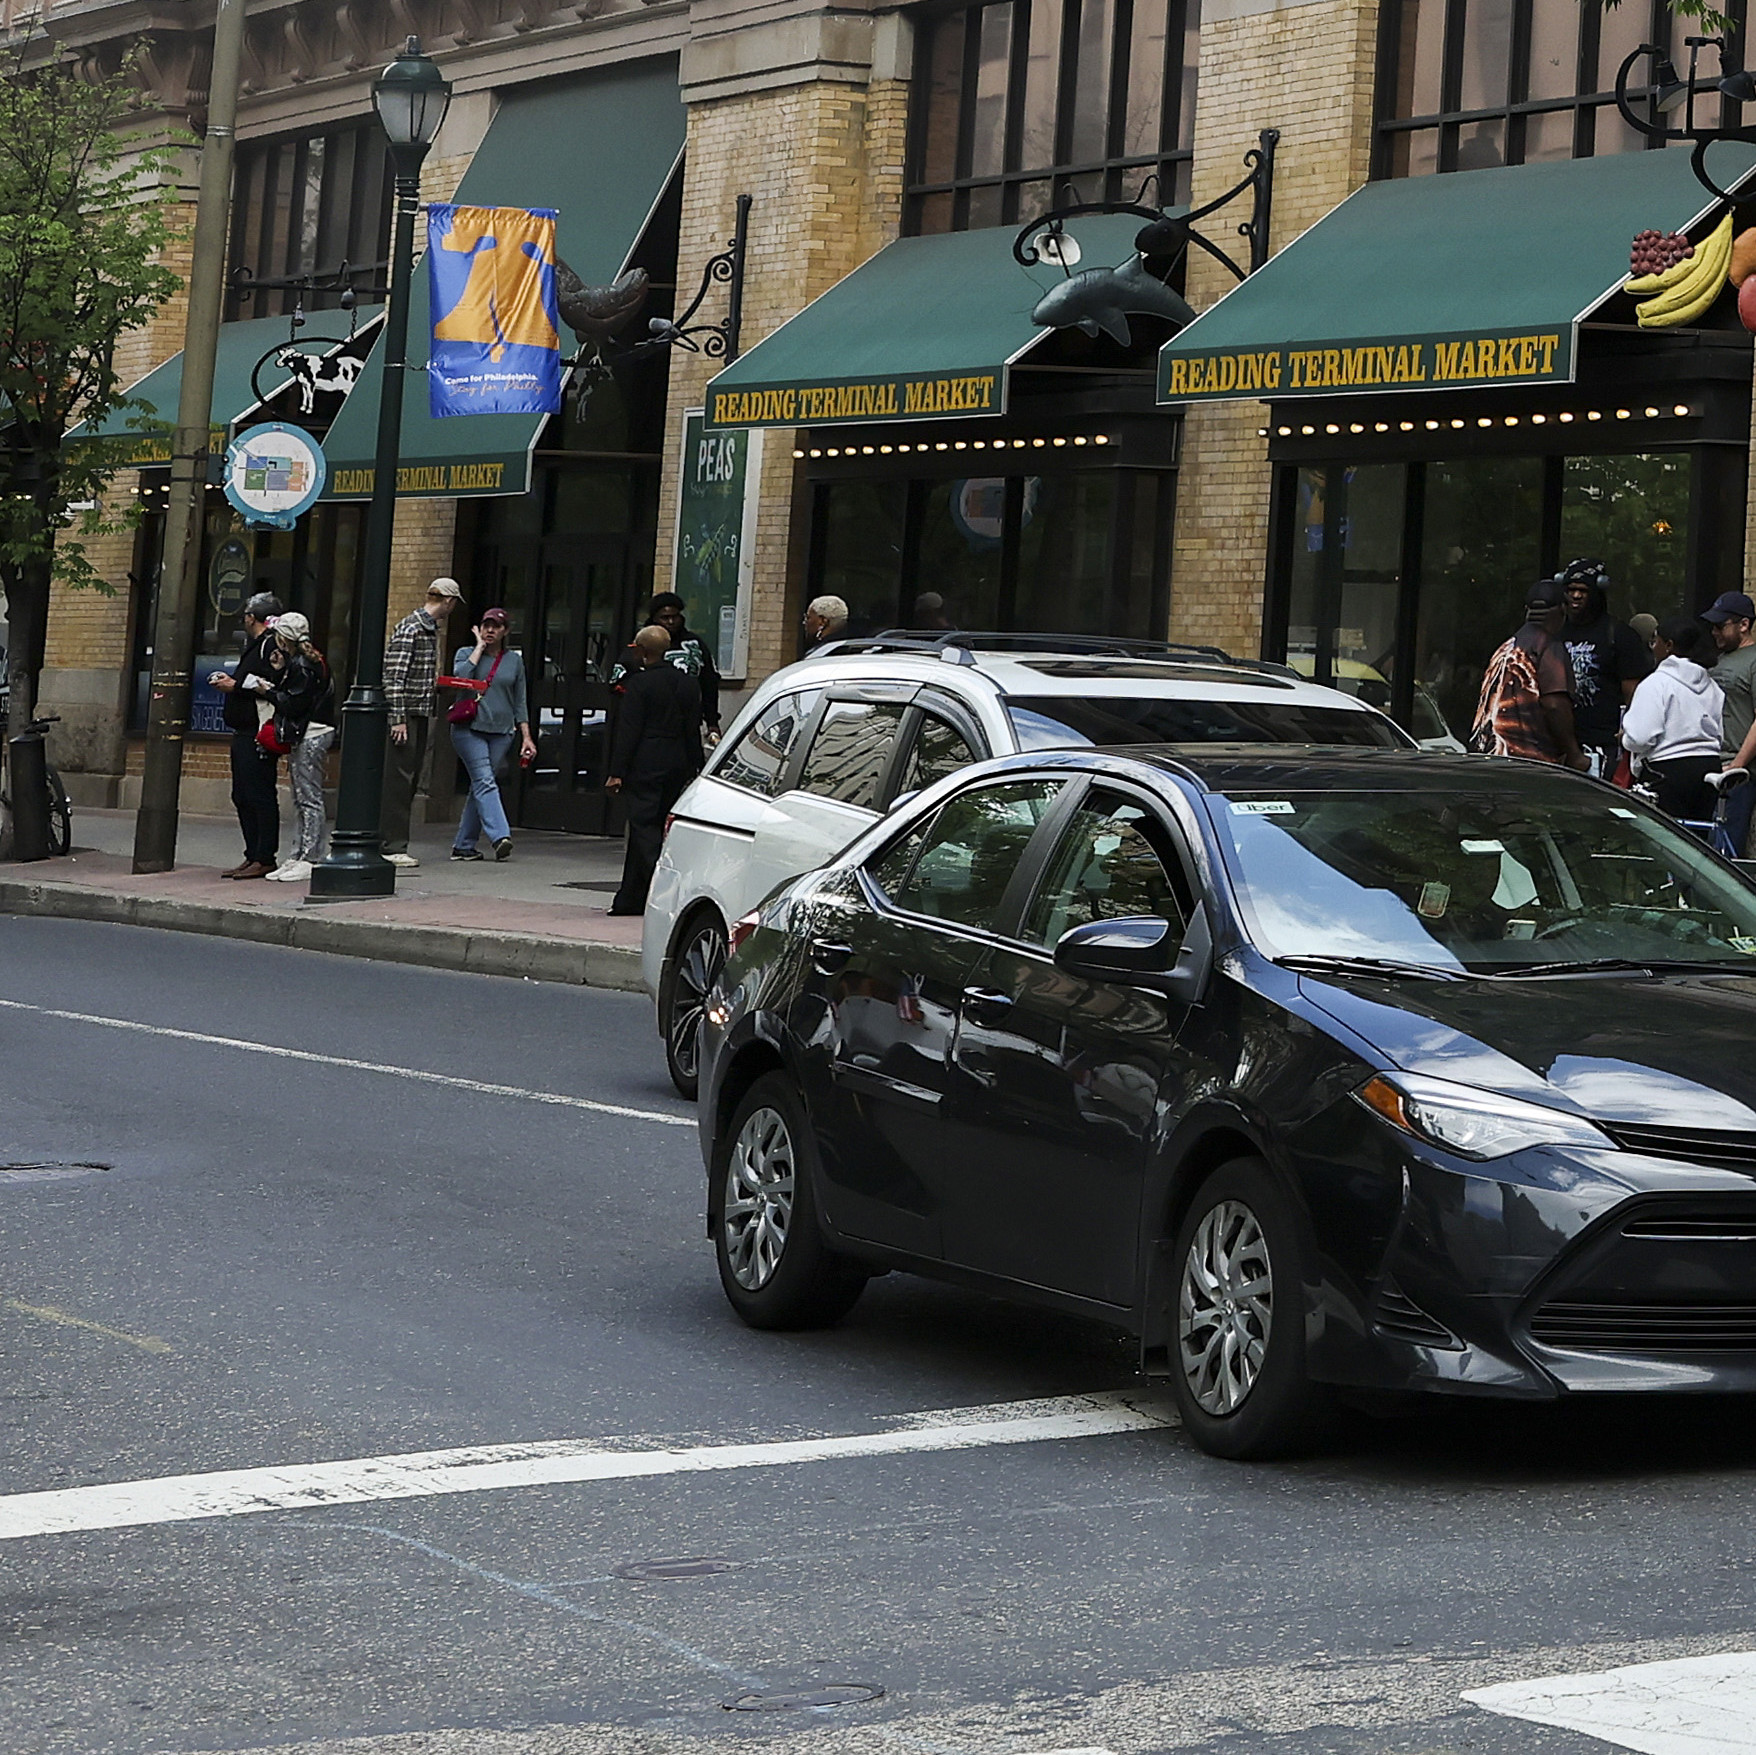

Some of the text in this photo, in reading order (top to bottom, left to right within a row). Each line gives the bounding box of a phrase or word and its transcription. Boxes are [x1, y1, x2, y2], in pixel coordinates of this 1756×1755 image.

[444, 376, 469, 385] Come
[470, 374, 484, 383] for
[1169, 334, 1559, 395] READING TERMINAL MARKET
[713, 375, 994, 424] READING TERMINAL MARKET
[333, 463, 504, 493] READIN ERMINAL MARKET
[696, 437, 736, 483] PEAS
[1237, 804, 1285, 812] Uber
